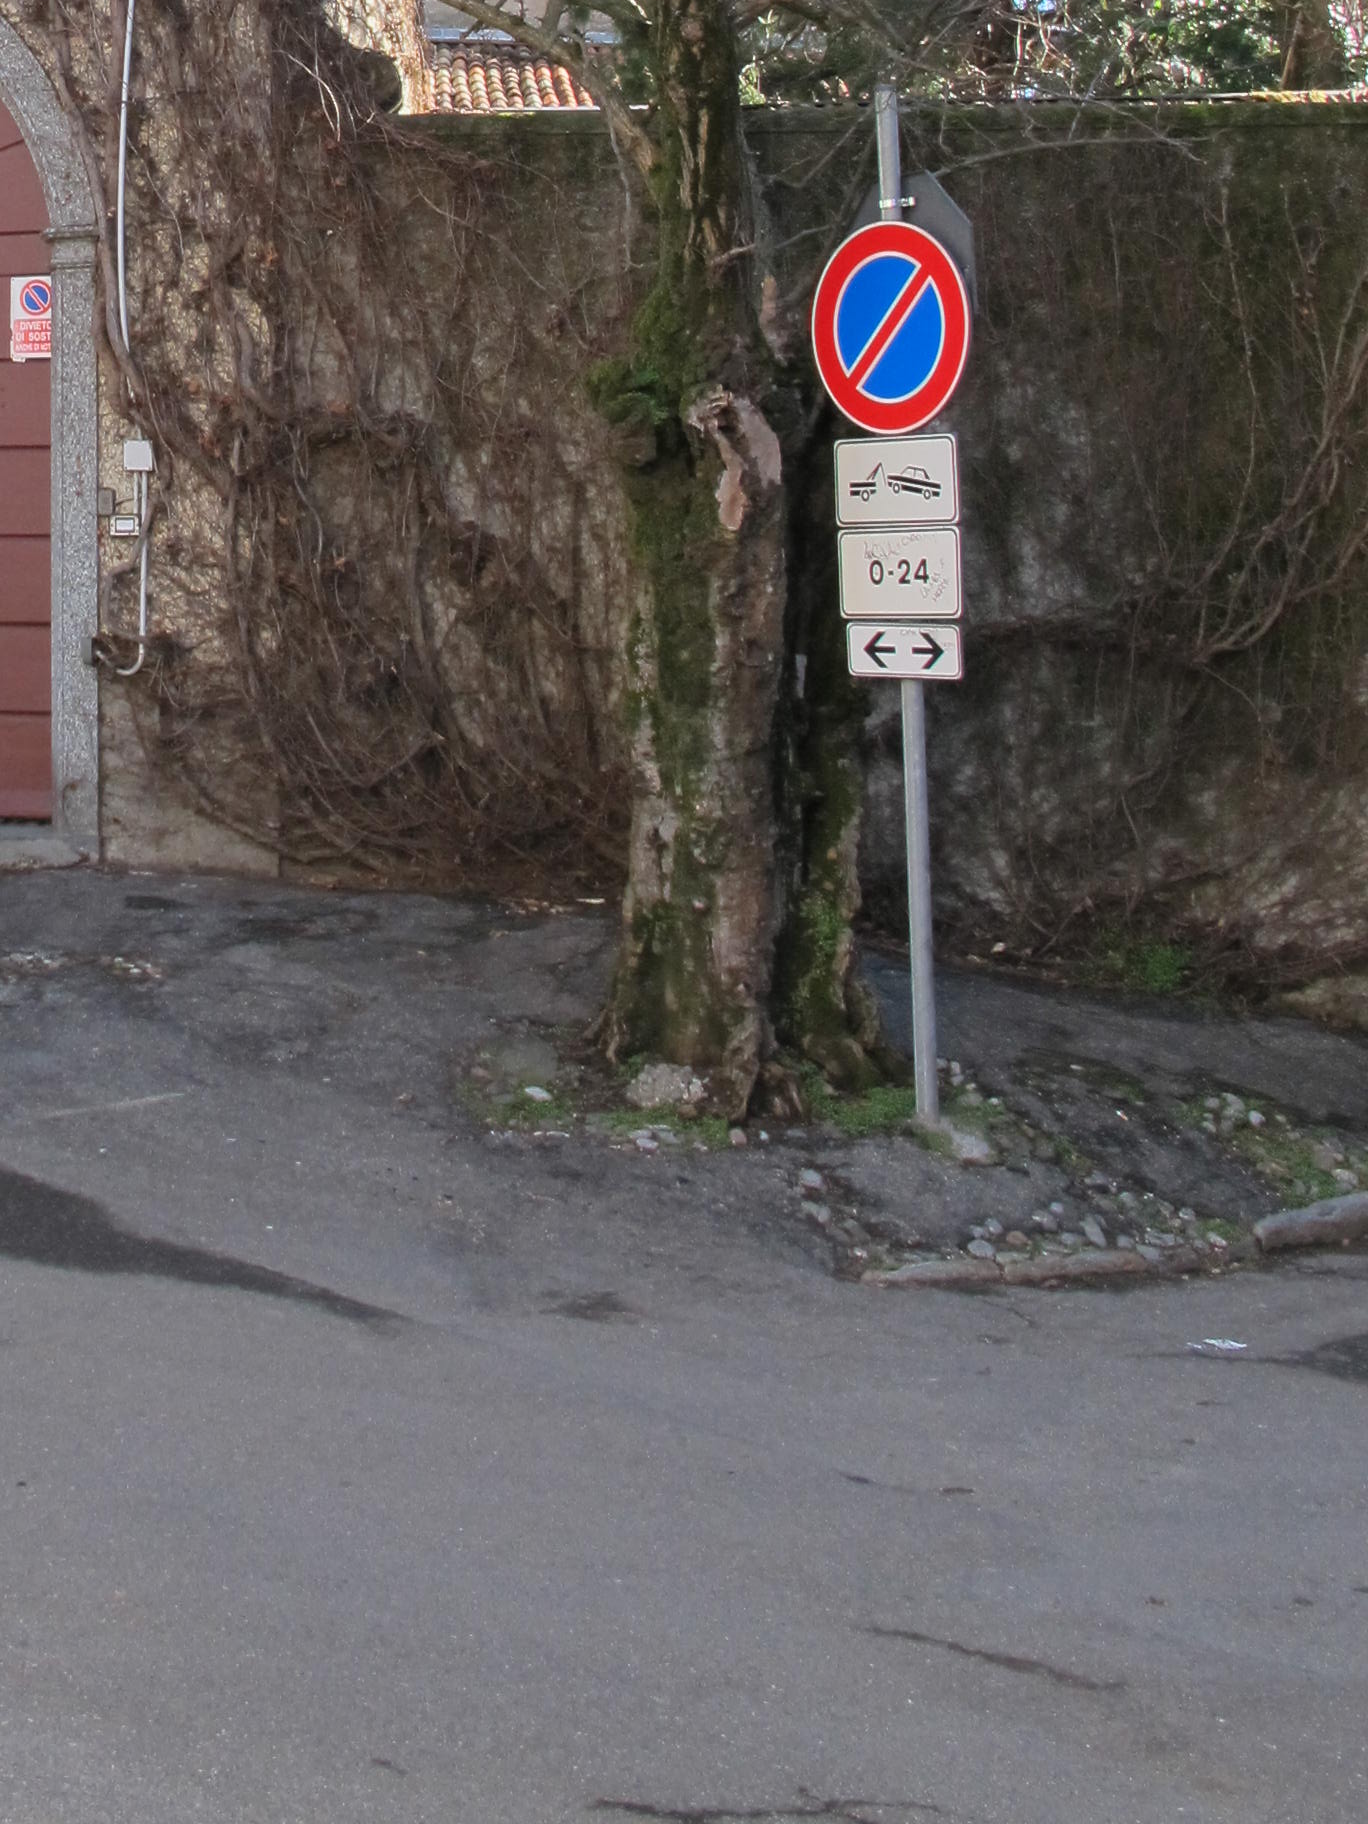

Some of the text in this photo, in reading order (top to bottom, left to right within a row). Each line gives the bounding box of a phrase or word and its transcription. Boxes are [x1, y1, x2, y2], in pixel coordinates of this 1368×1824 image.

[15, 331, 52, 342] DI SOST
[869, 558, 930, 586] 0-24
